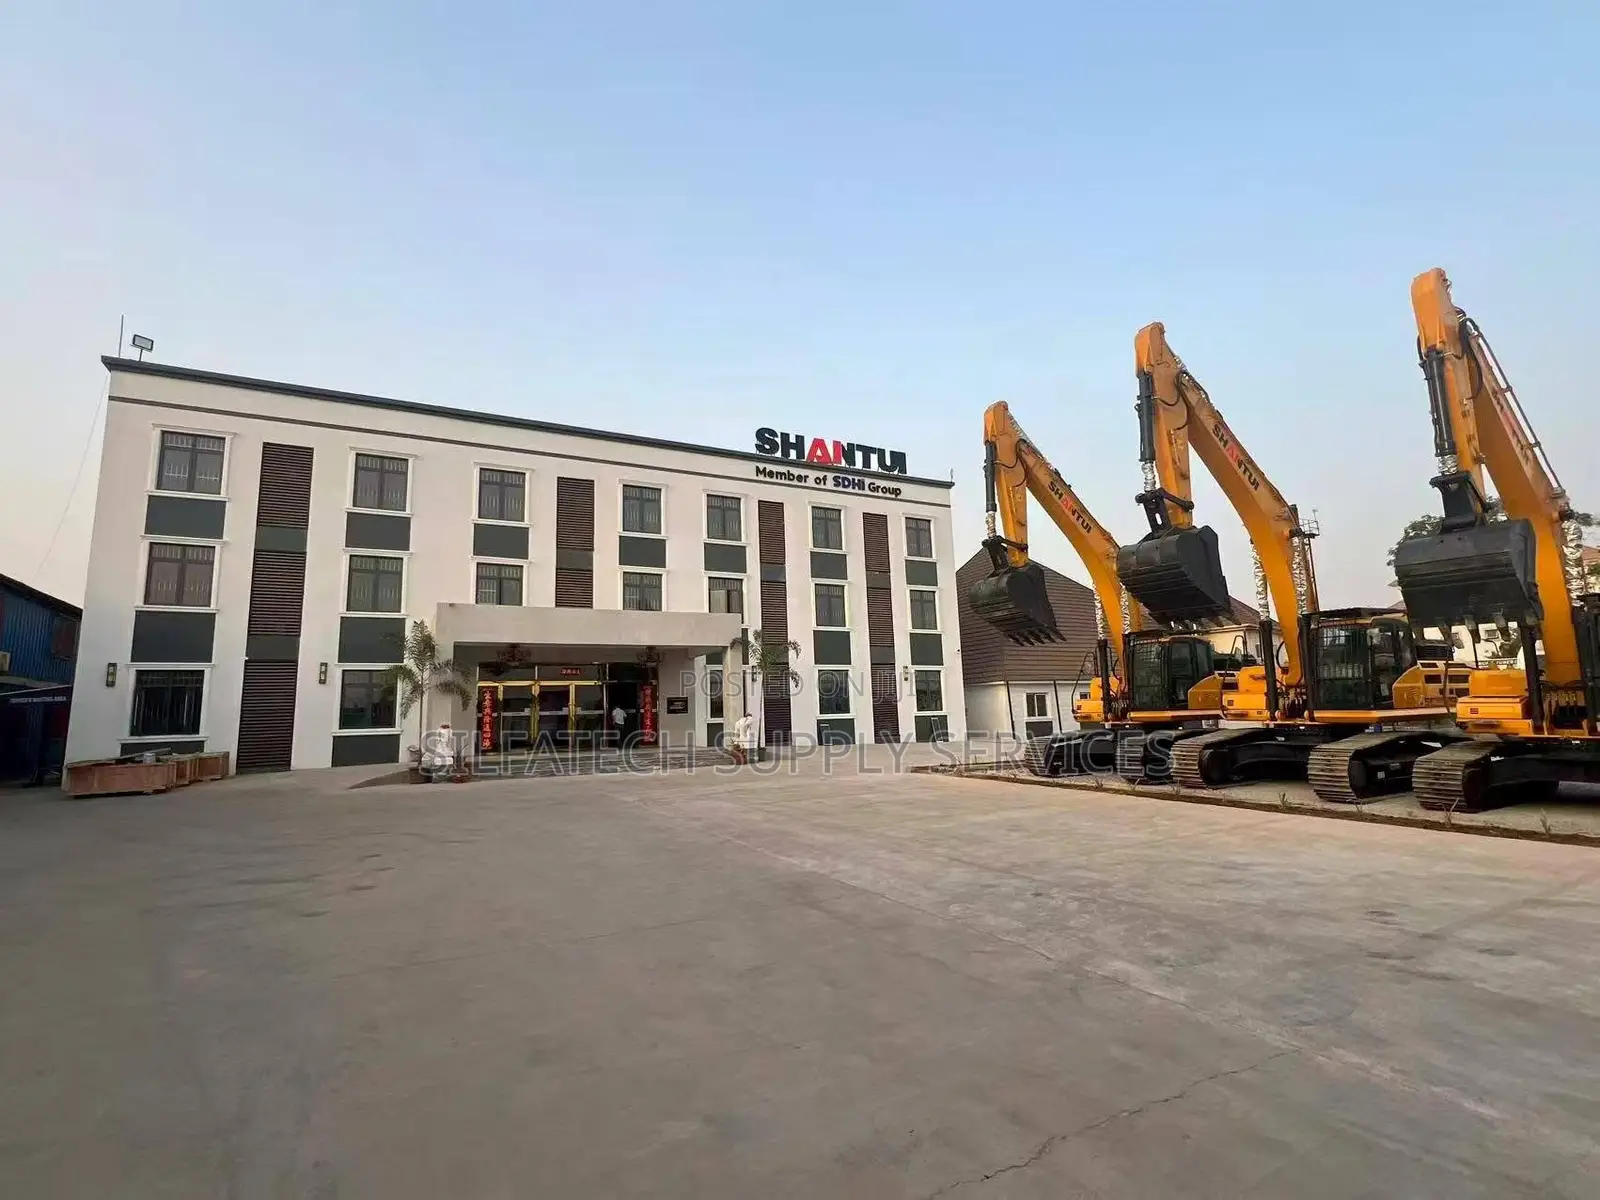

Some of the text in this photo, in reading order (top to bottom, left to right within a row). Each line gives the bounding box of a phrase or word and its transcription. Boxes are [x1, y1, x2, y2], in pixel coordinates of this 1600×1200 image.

[755, 427, 908, 475] SHANTUI
[1211, 423, 1261, 492] SHANTUI
[755, 465, 809, 484] Member
[814, 473, 830, 486] of
[868, 482, 902, 498] Group
[1048, 480, 1092, 534] SHANTUI
